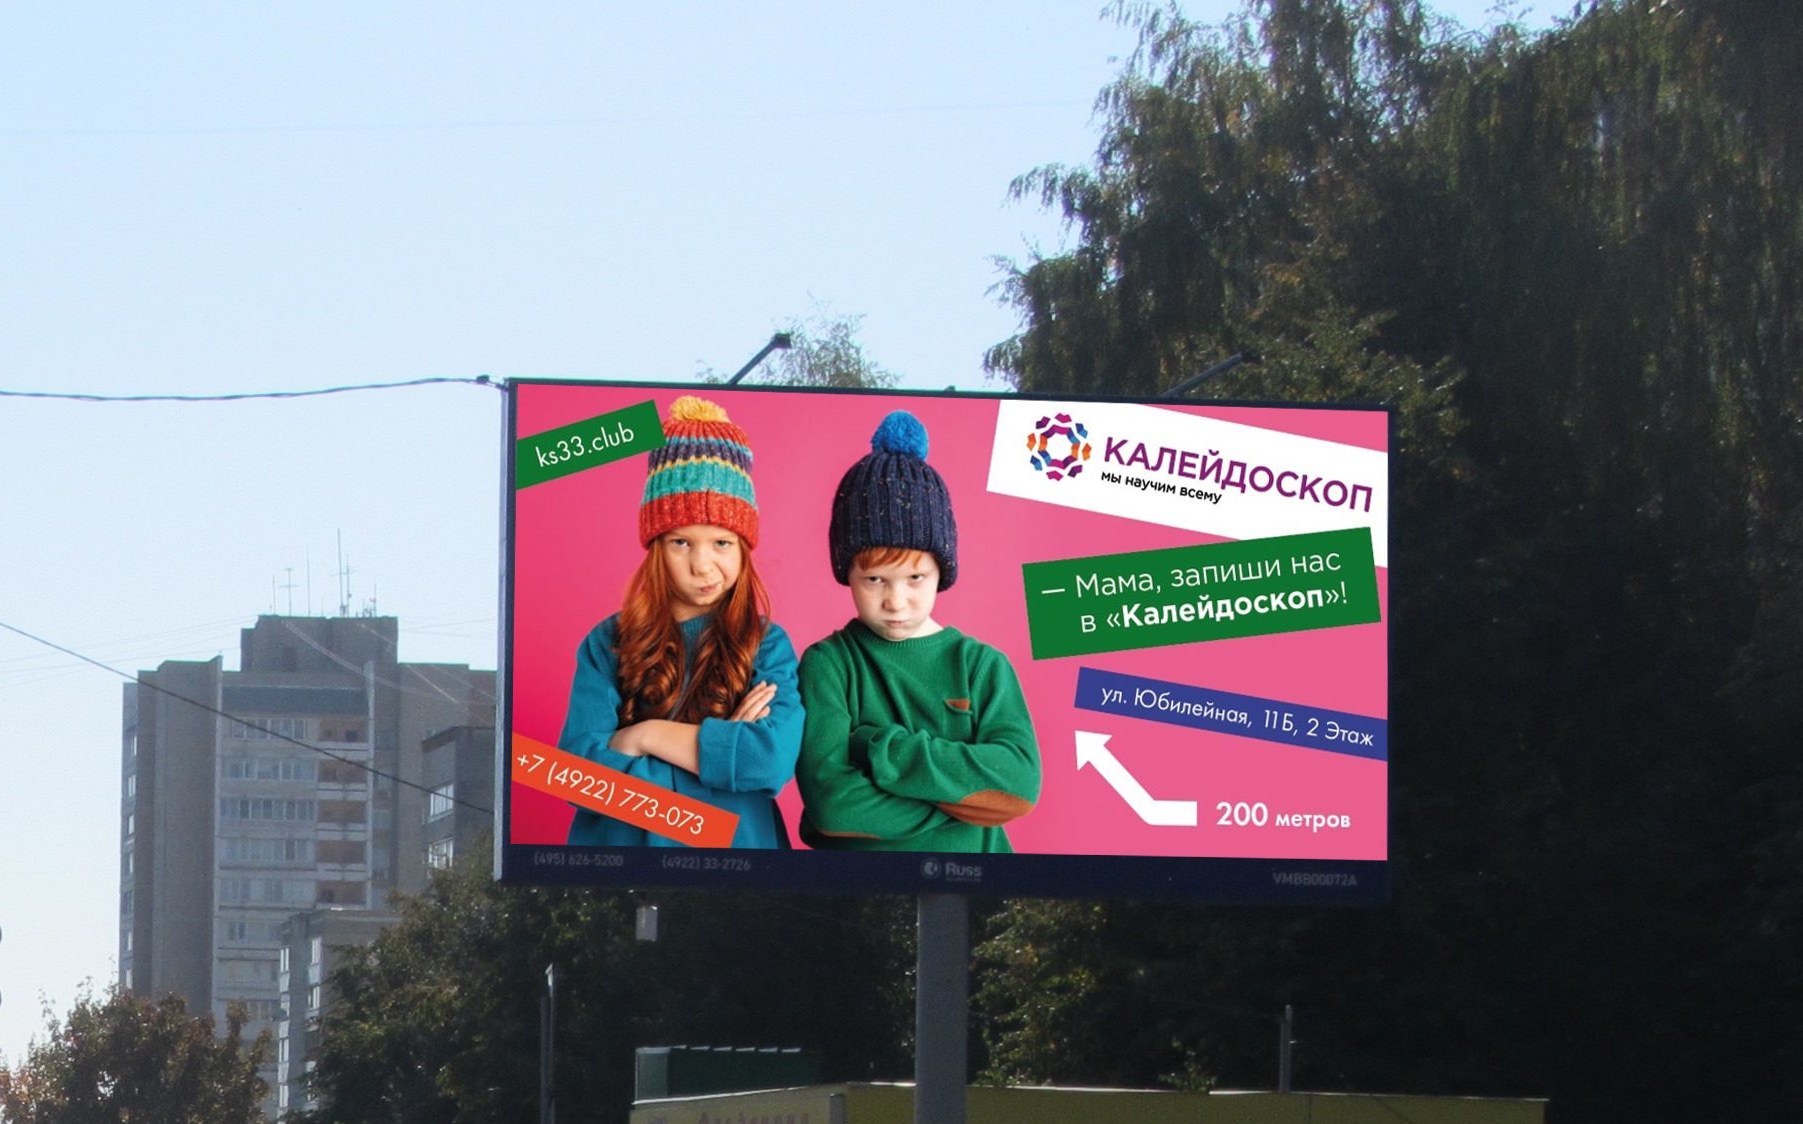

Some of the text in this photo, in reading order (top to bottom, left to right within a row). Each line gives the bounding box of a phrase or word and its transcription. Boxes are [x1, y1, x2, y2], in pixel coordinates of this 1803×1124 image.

[535, 422, 634, 467] ks33.club
[1101, 471, 1222, 504] мы научим всему
[1104, 436, 1373, 513] КАЛЕЙДОСКОП
[1075, 572, 1161, 599] Мама,
[1170, 558, 1281, 588] запиши
[1290, 551, 1342, 575] нас
[1080, 581, 1348, 633] в «Калейдоскоп»!
[1101, 687, 1128, 706] ул.
[1134, 687, 1253, 728] Юбилейная,
[1306, 717, 1319, 736] 2
[1325, 721, 1374, 746] Этаж
[517, 754, 705, 835] +7 (4922) 773-073
[1216, 801, 1352, 833] 200 метров
[534, 851, 624, 867] (495) 626-5200
[662, 855, 752, 871] (4922) 33-2726
[945, 861, 982, 877] Russ
